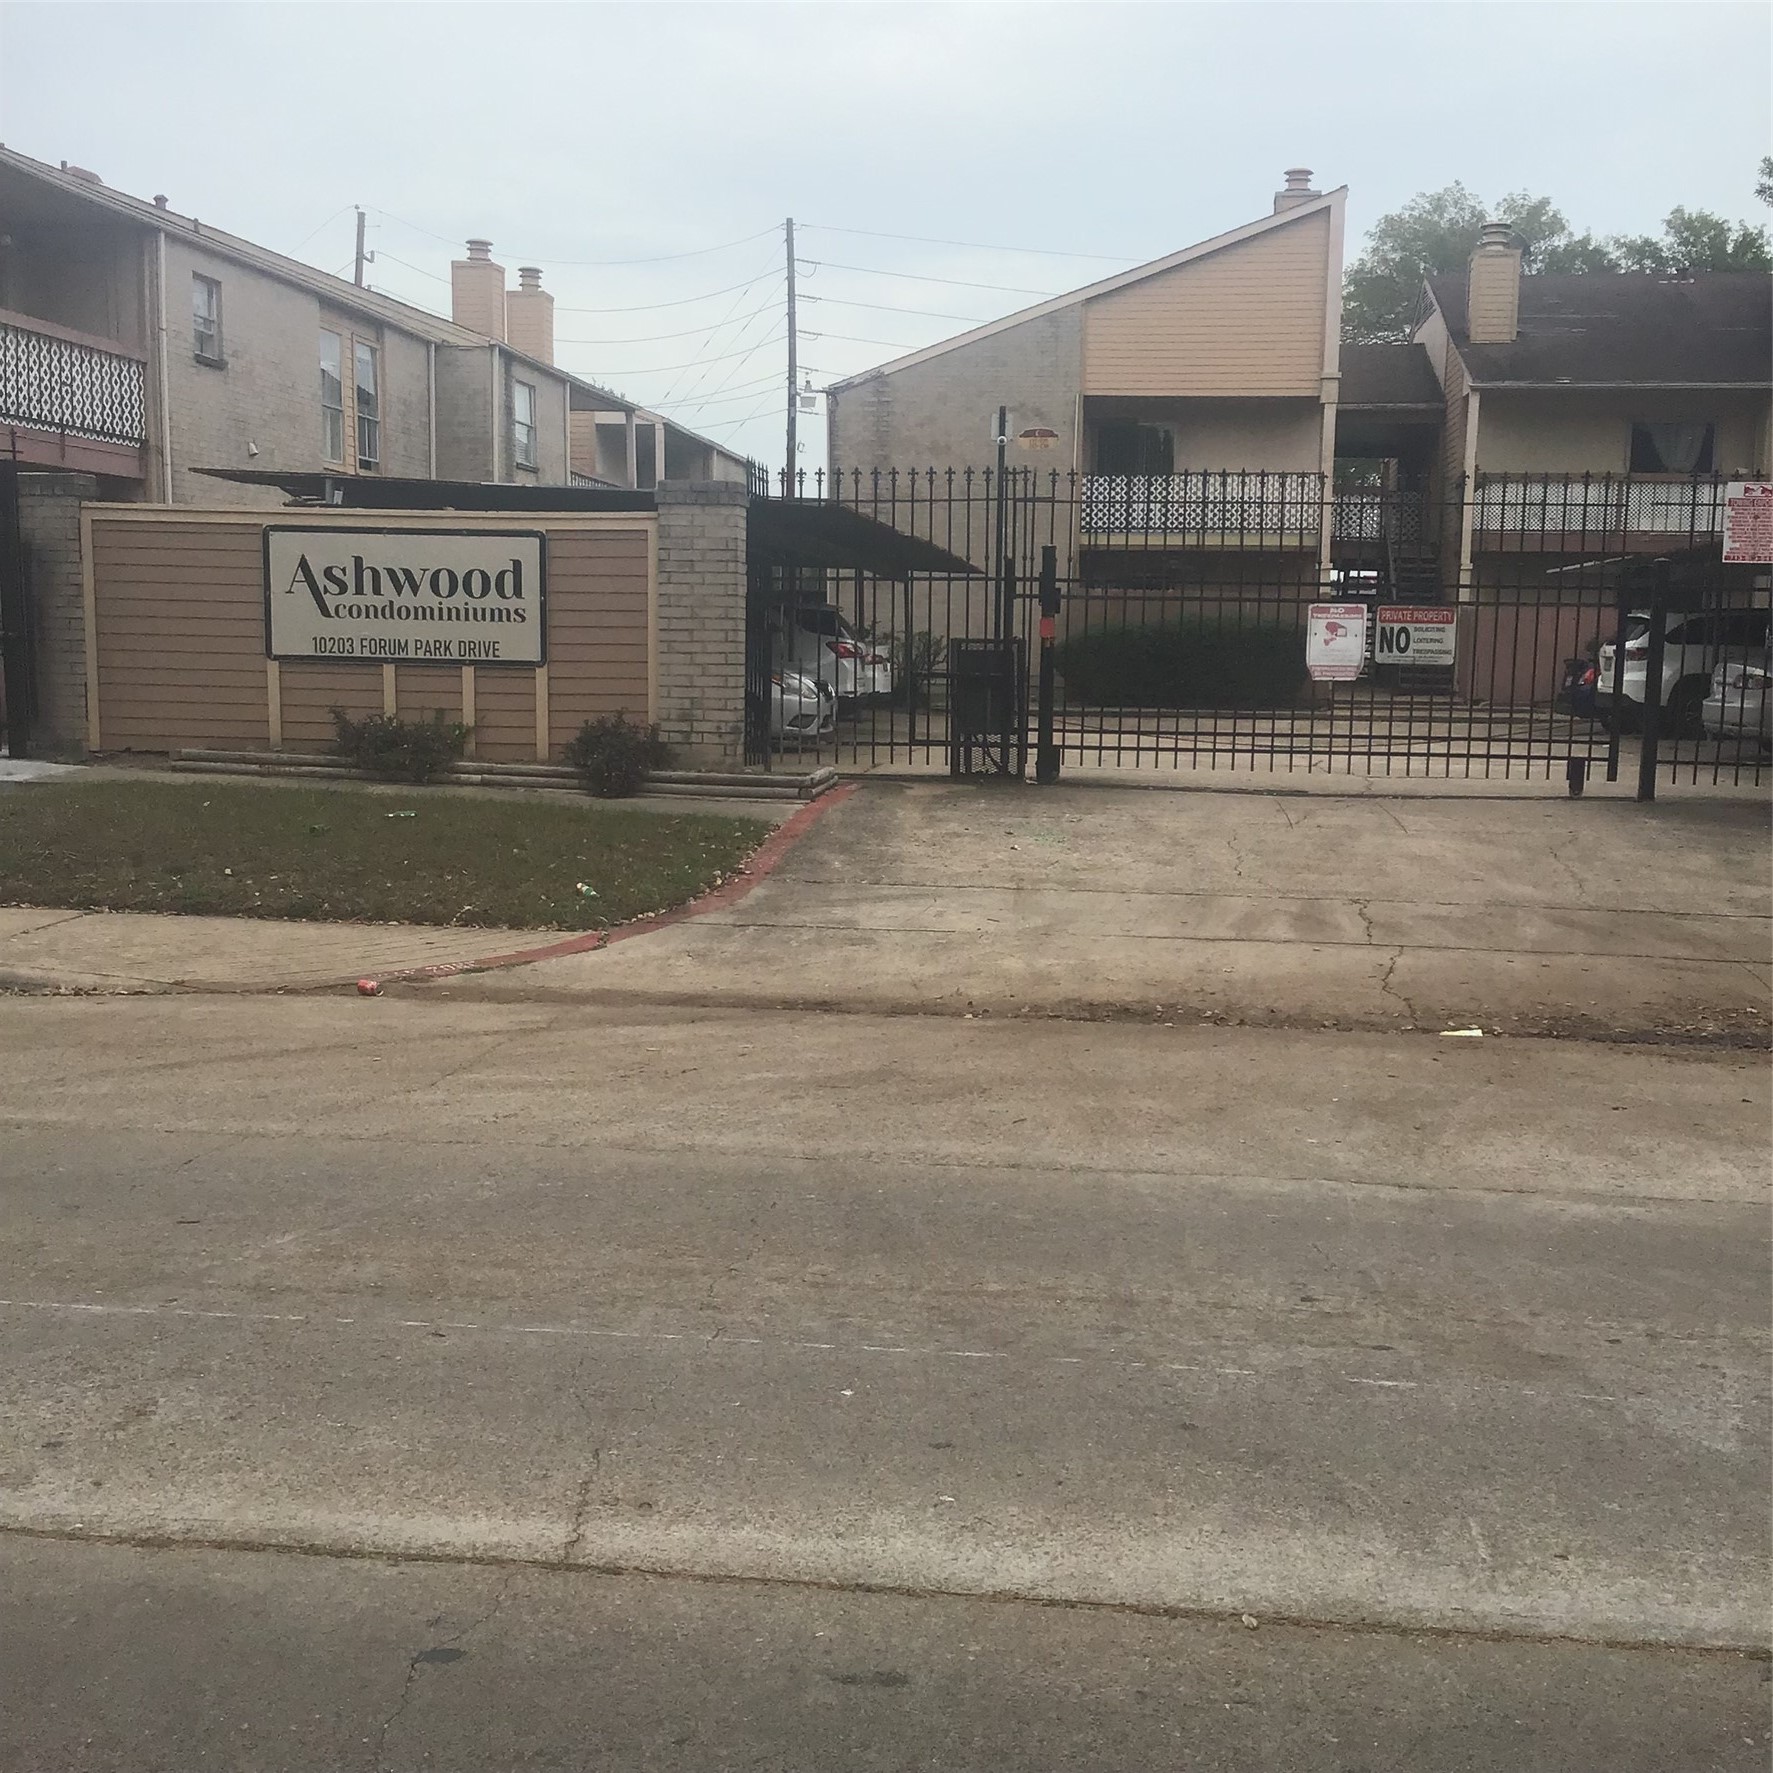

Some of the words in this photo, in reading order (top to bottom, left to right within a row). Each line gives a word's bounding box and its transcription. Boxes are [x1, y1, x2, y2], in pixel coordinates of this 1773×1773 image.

[285, 553, 525, 618] Ashwood
[334, 600, 527, 623] condominiums
[1381, 610, 1412, 621] PRIVATE
[1413, 610, 1453, 621] PROPERTY
[312, 636, 355, 655] 10203
[360, 637, 409, 656] FORUM
[415, 638, 453, 657] PARK
[458, 640, 500, 658] DRIVE
[1379, 626, 1411, 654] NO
